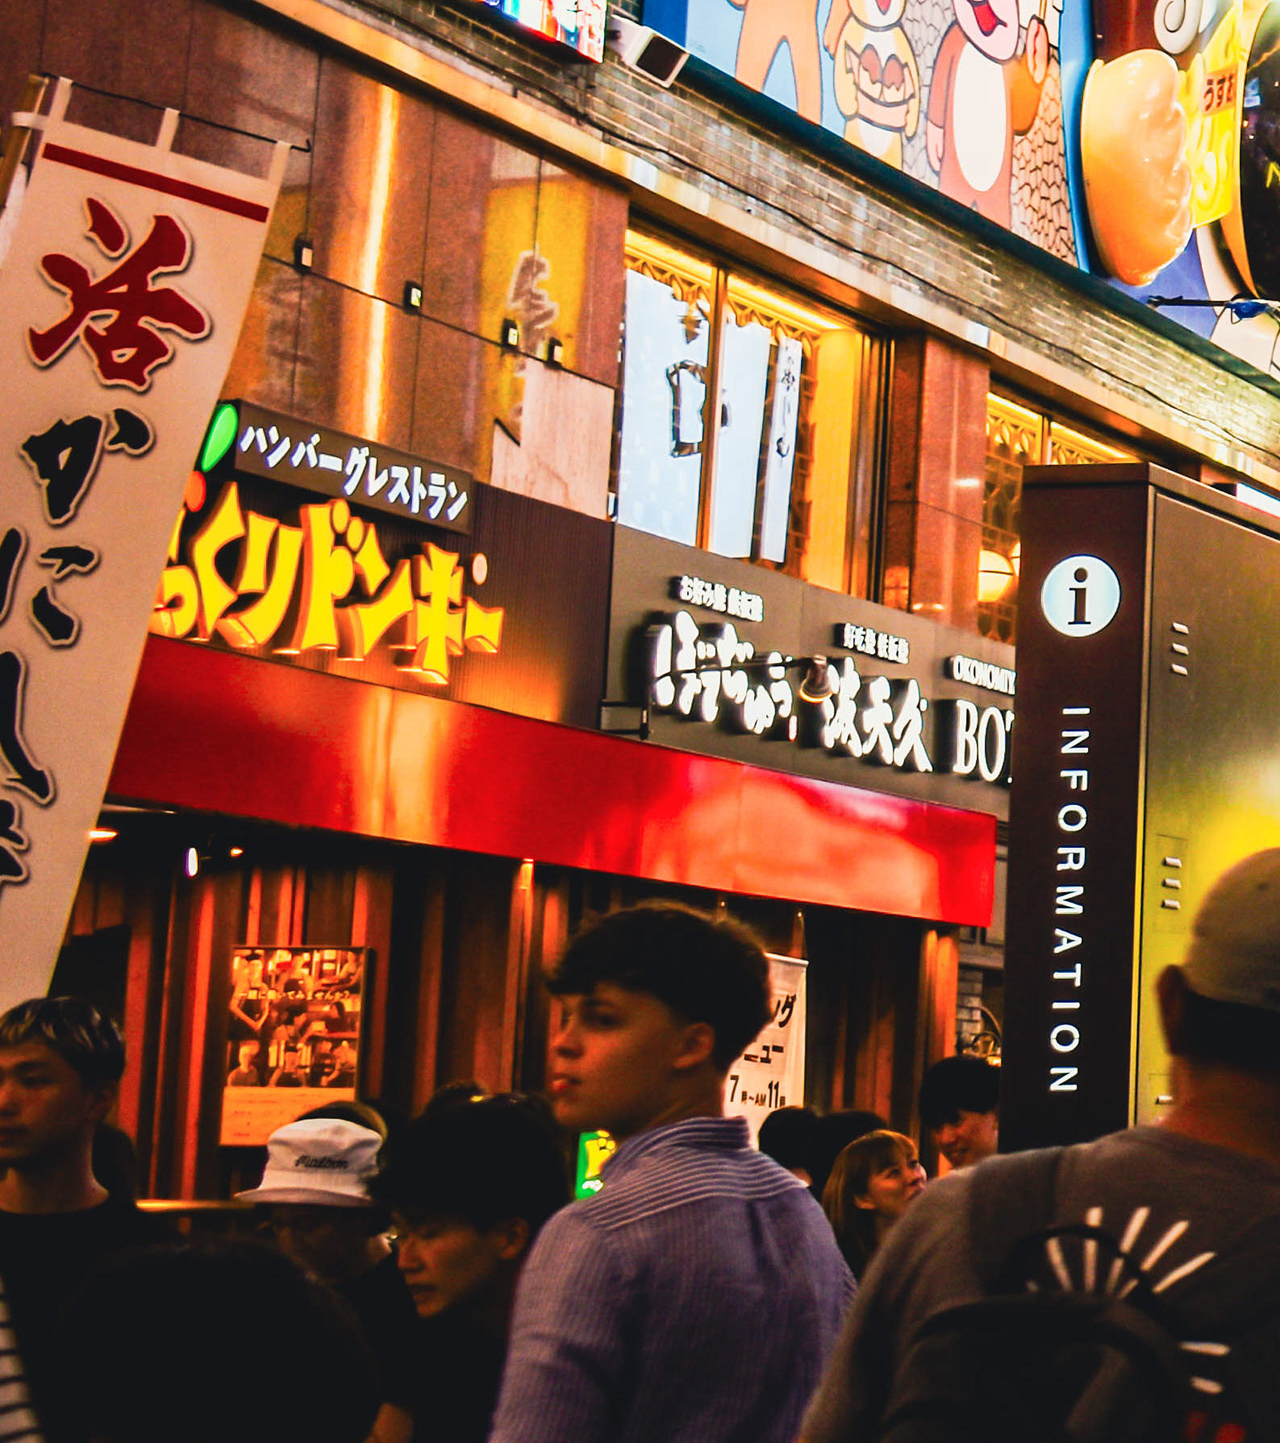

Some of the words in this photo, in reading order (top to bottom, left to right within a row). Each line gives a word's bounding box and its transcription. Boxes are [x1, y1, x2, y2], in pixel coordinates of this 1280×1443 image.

[240, 424, 468, 521] ハンバーグレストラン
[1049, 705, 1092, 1093] INFORMATION
